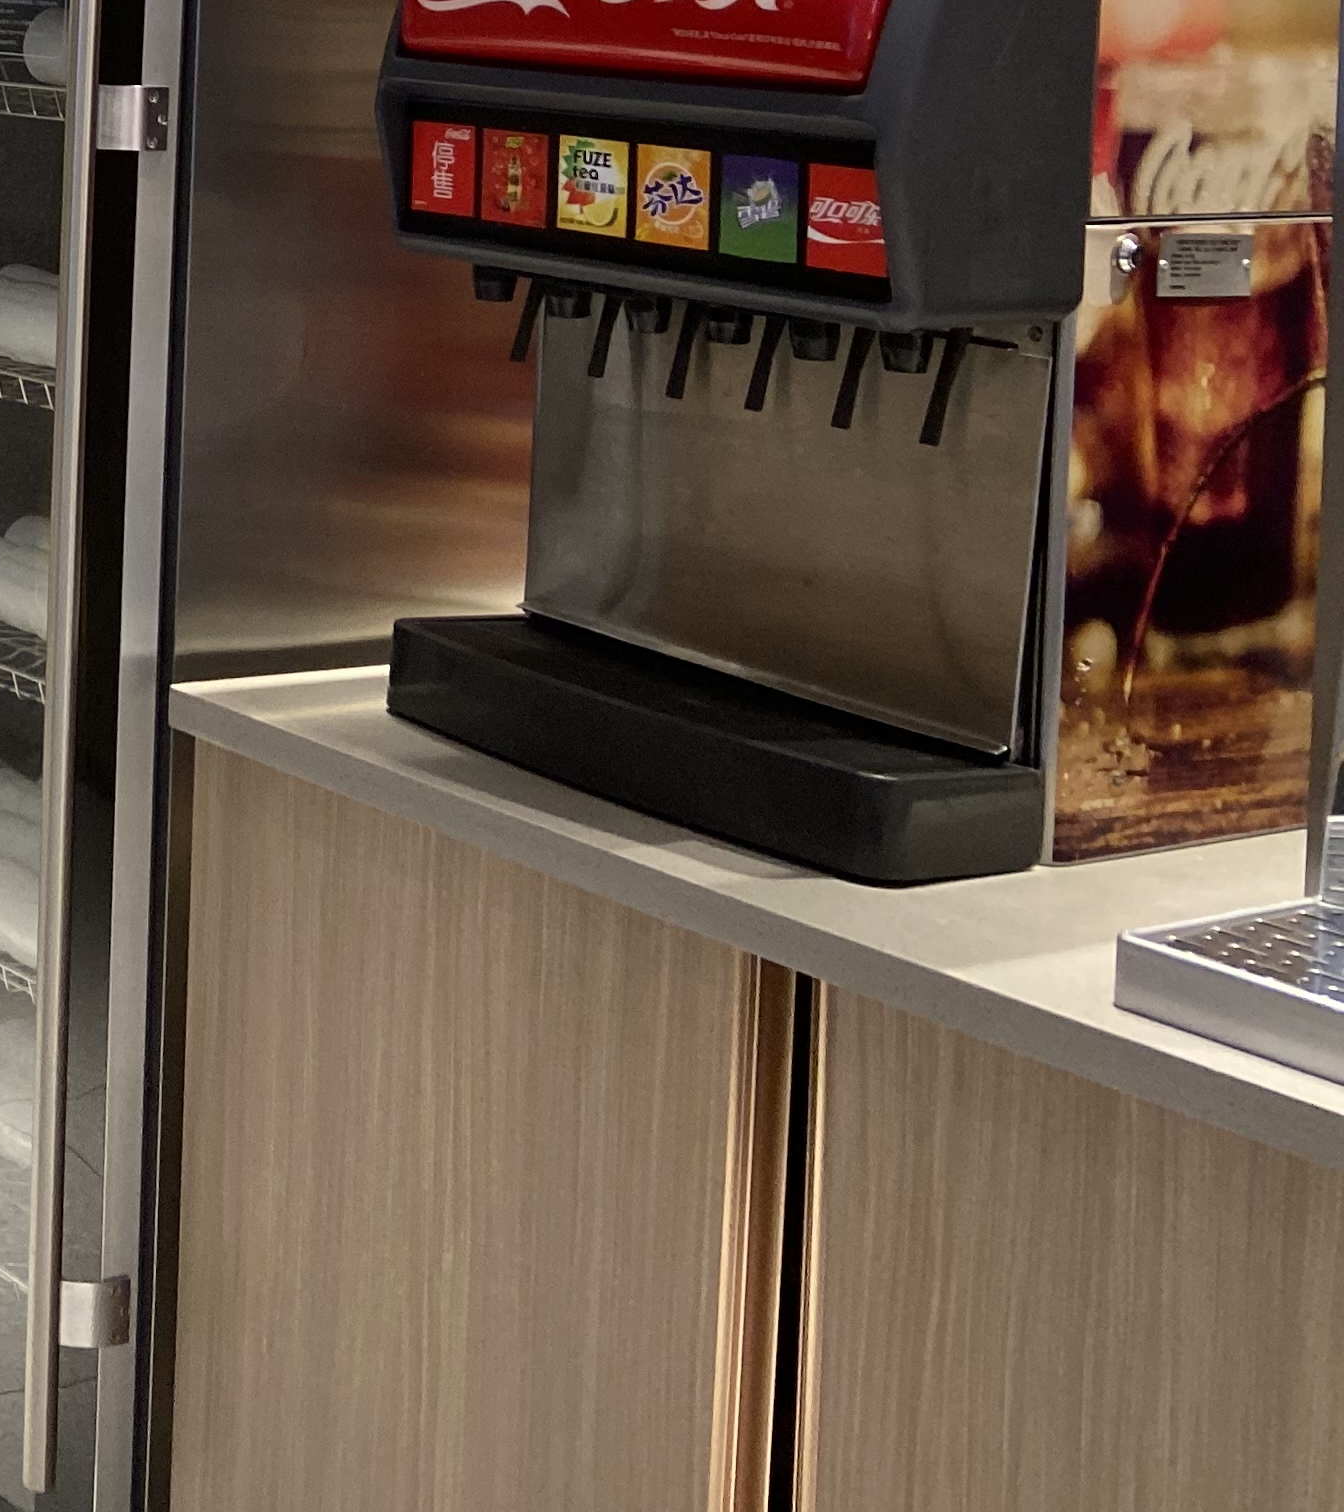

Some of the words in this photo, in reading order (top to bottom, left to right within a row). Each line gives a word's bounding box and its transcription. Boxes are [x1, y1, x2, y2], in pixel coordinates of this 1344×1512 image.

[574, 149, 612, 168] FUZE
[573, 166, 599, 180] tea
[642, 173, 703, 217] 芬达
[809, 196, 882, 226] 可口可乐
